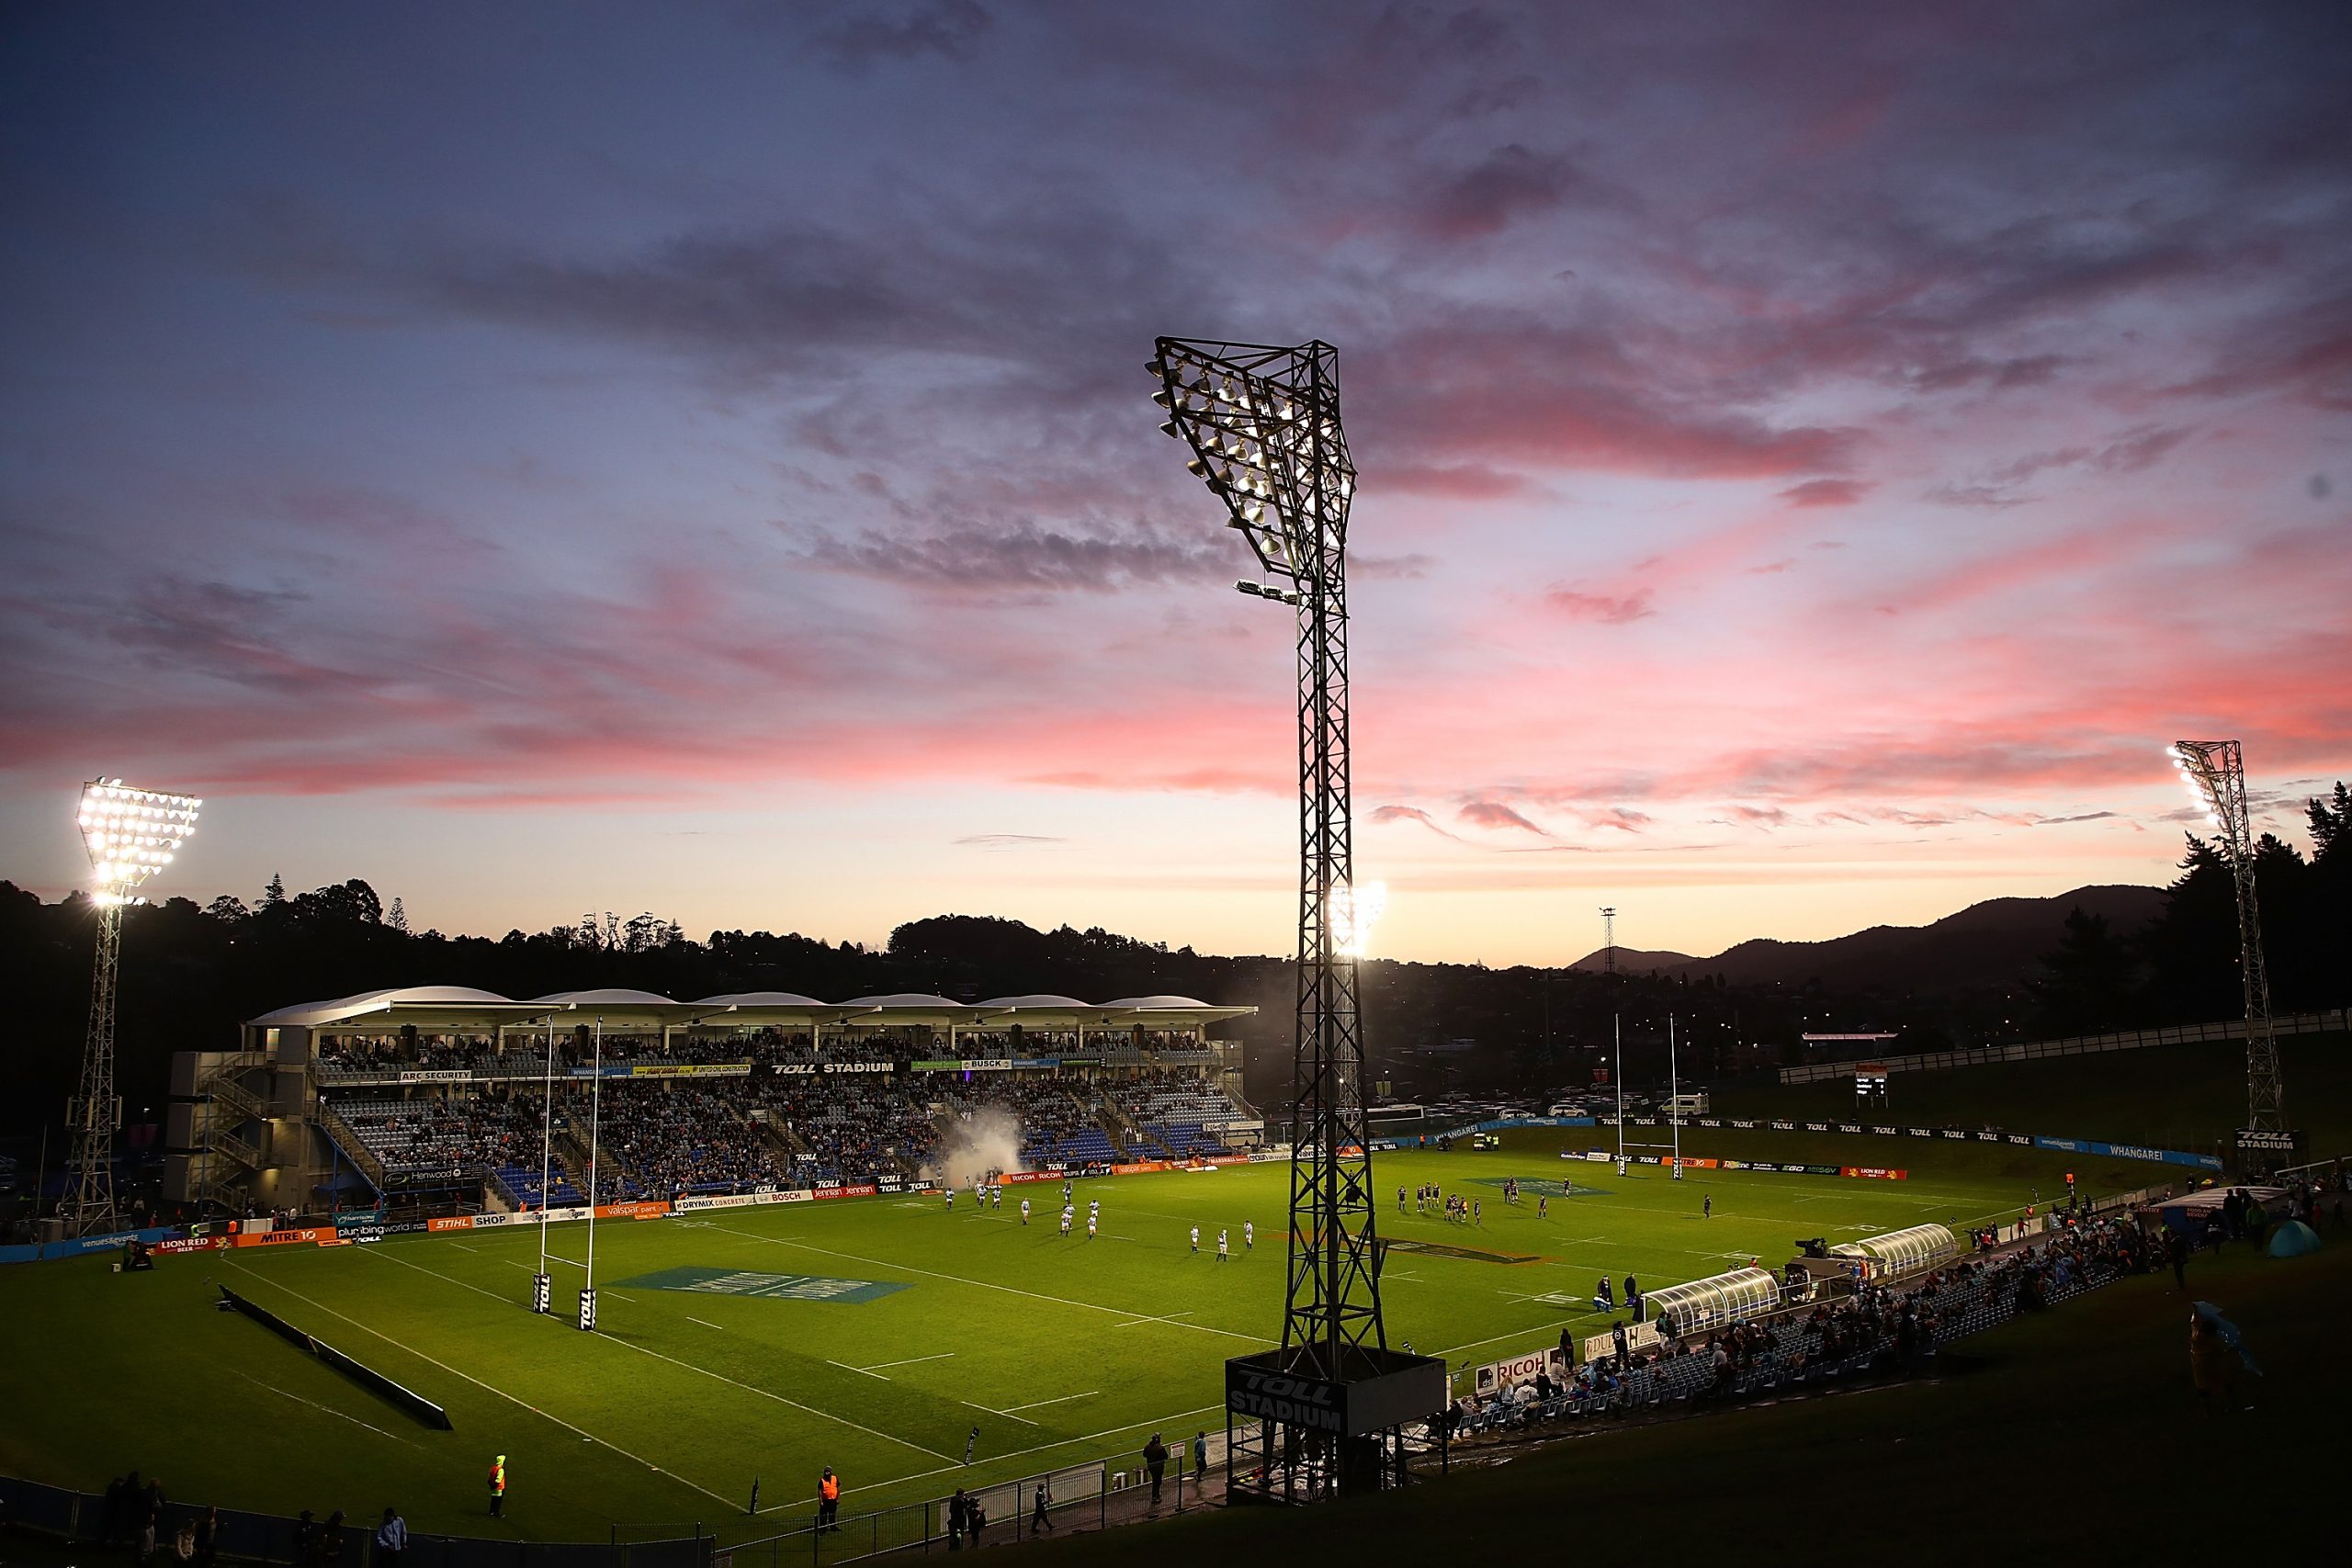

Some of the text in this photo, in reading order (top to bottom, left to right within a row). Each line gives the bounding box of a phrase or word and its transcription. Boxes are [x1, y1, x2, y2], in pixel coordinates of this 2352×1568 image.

[771, 1063, 894, 1074] TOLL STADIUM
[425, 1071, 470, 1079] SECURITY
[1700, 1119, 1721, 1127] TOLL
[1732, 1120, 1754, 1128] TOLL
[1770, 1122, 1794, 1130] TOLL
[1806, 1122, 1828, 1131] TOLL
[1839, 1124, 1861, 1133] TOLL
[1872, 1126, 1896, 1135] TOLL
[1909, 1128, 1931, 1136] TOLL
[1942, 1130, 1965, 1139] TOLL
[1977, 1132, 1998, 1142] TOLL
[2007, 1134, 2030, 1145] TOLL
[2236, 1131, 2291, 1141] TOLL
[2236, 1140, 2294, 1149] STADIUM
[796, 1153, 818, 1161] TOLL
[2109, 1145, 2163, 1161] WHANGAREI
[1046, 1162, 1068, 1170] TOLL
[412, 1169, 452, 1179] Henwood
[877, 1174, 902, 1183] TOLL
[1012, 1173, 1035, 1181] RICOH
[1039, 1171, 1061, 1179] RICOH
[755, 1183, 778, 1193] TOLL
[815, 1179, 841, 1188] TOLL
[878, 1184, 902, 1192] TOLL
[909, 1181, 931, 1190] TOLL
[813, 1188, 842, 1198] Jennian
[845, 1186, 874, 1196] Jennian
[772, 1192, 801, 1201] BOSCH
[683, 1200, 715, 1209] DRYMIX
[715, 1197, 745, 1206] CONCRETE
[607, 1204, 639, 1216] valspar
[436, 1218, 469, 1229] STIHL
[476, 1215, 505, 1225] SHOP
[260, 1230, 316, 1244] MITRE 10
[162, 1237, 209, 1249] LION RED
[539, 1276, 550, 1313] TOLL
[581, 1291, 592, 1330] TOLL
[1499, 1358, 1544, 1378] RICOH
[1483, 1377, 1494, 1387] dsl
[1237, 1370, 1332, 1406] TOLL
[1230, 1390, 1341, 1433] STADIUM
